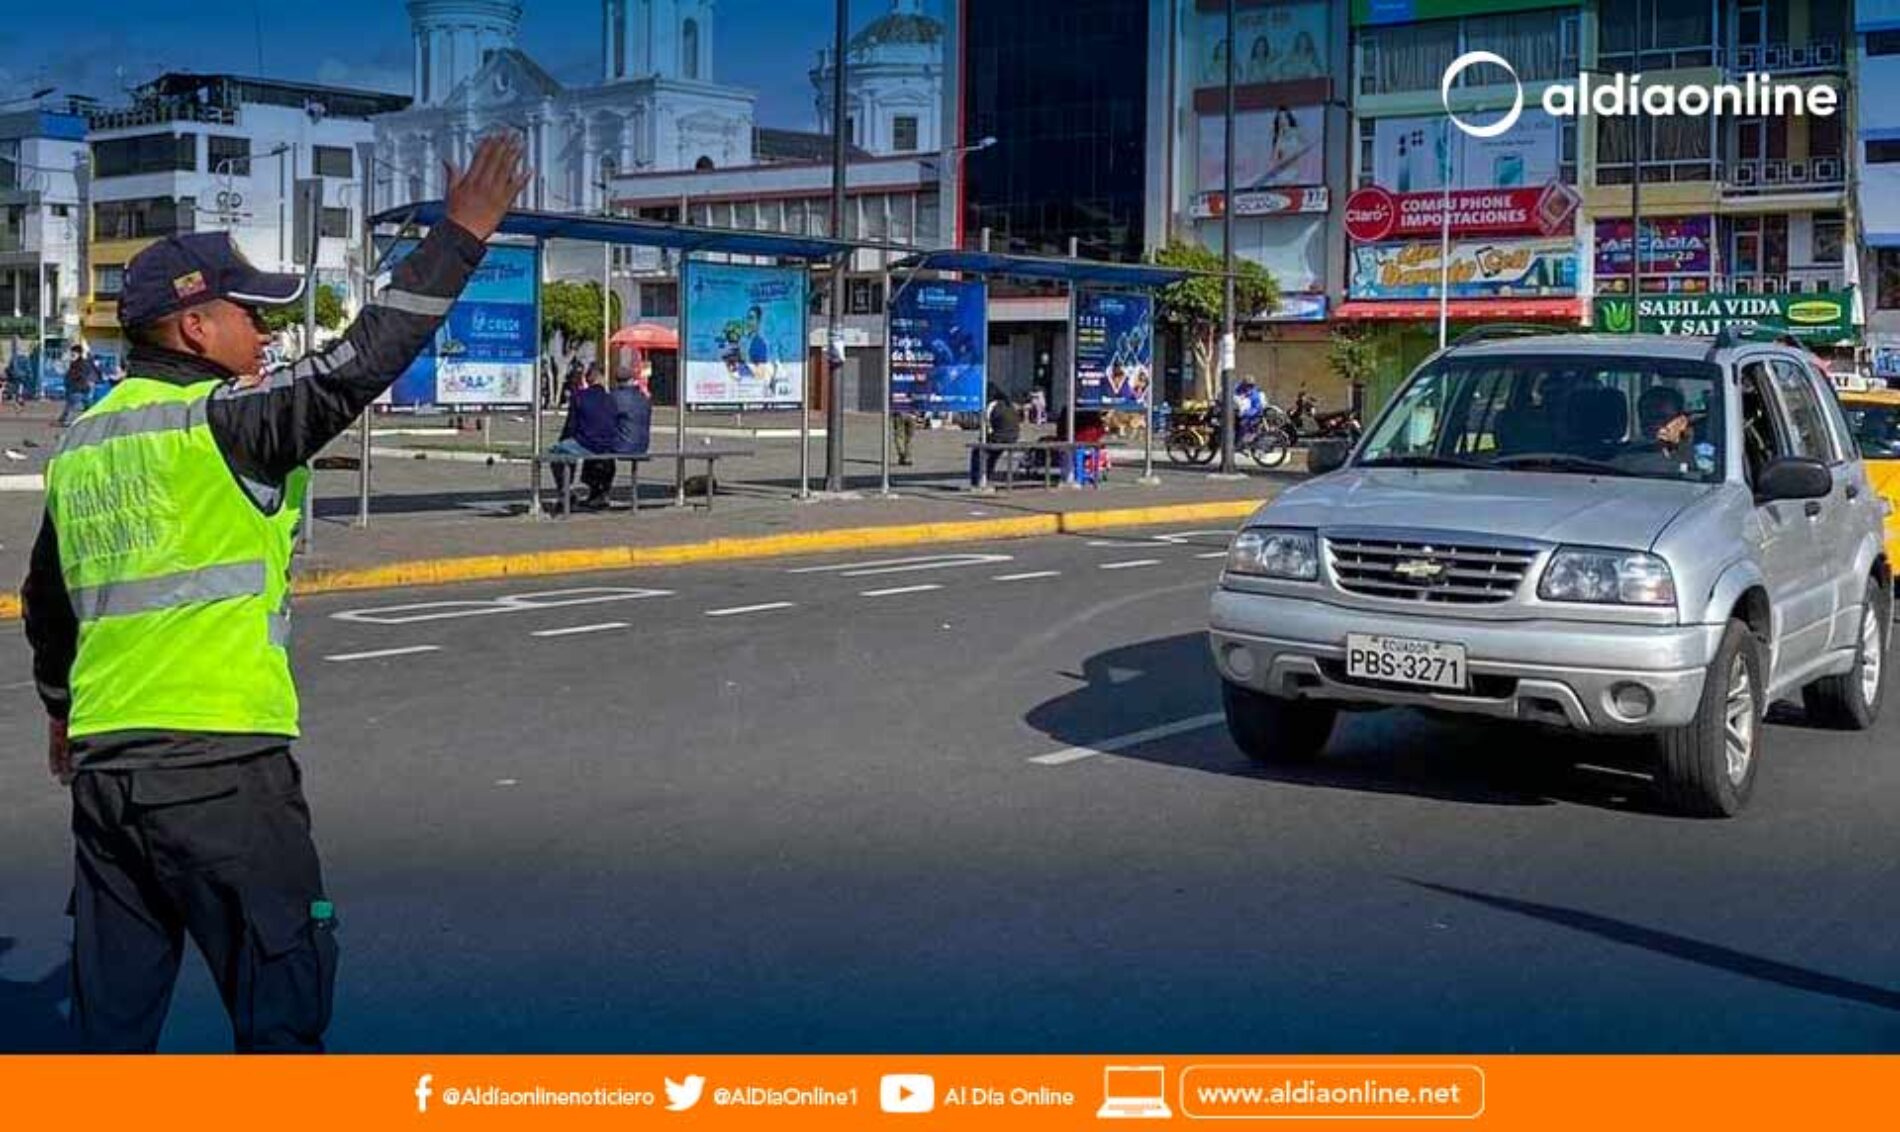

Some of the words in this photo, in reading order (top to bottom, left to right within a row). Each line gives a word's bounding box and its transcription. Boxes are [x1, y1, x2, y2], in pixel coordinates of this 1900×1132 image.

[1401, 197, 1456, 212] COMPU
[1460, 195, 1512, 208] PHONE
[1639, 299, 1721, 316] SABILA
[1724, 298, 1782, 316] VIDA
[1660, 319, 1676, 335] Y
[1350, 648, 1458, 685] PBS-3271
